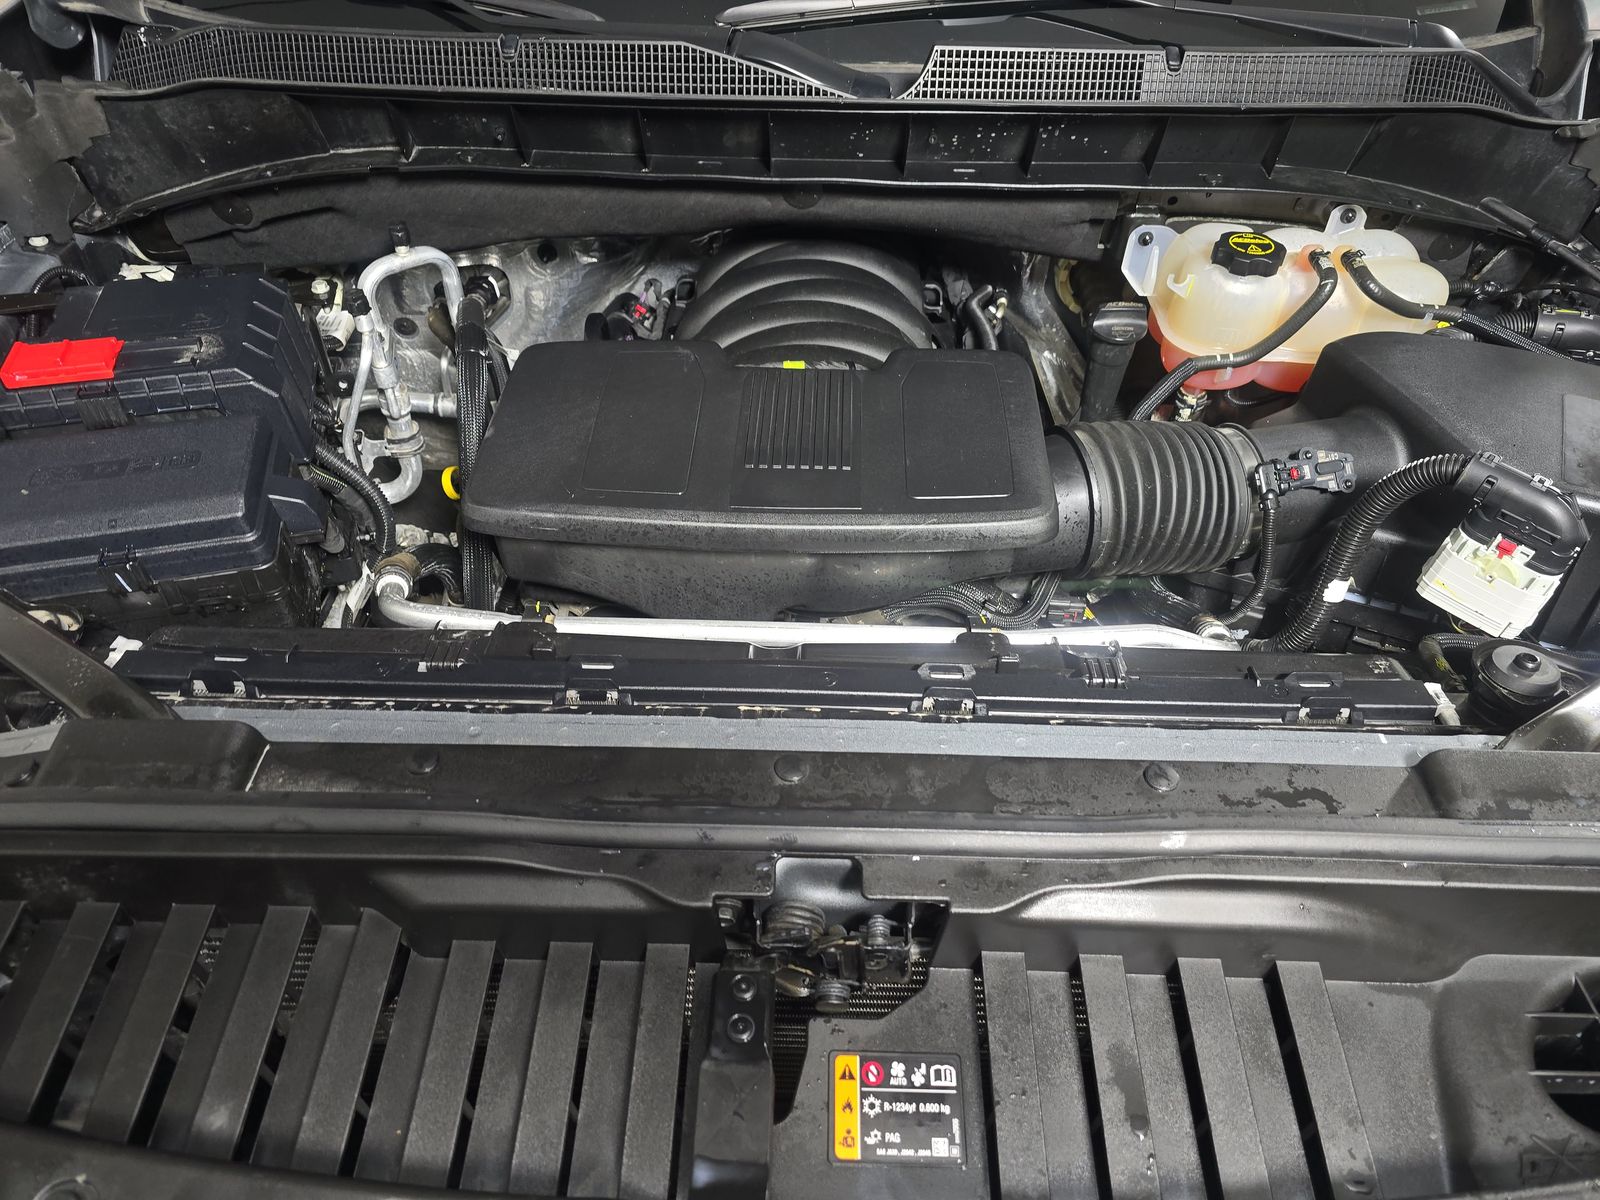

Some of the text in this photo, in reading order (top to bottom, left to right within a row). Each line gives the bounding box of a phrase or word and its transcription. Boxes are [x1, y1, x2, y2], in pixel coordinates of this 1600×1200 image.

[889, 1077, 908, 1086] AUTO
[883, 1101, 917, 1114] R-1234yf
[940, 1103, 951, 1115] kg
[884, 1132, 901, 1143] PAG
